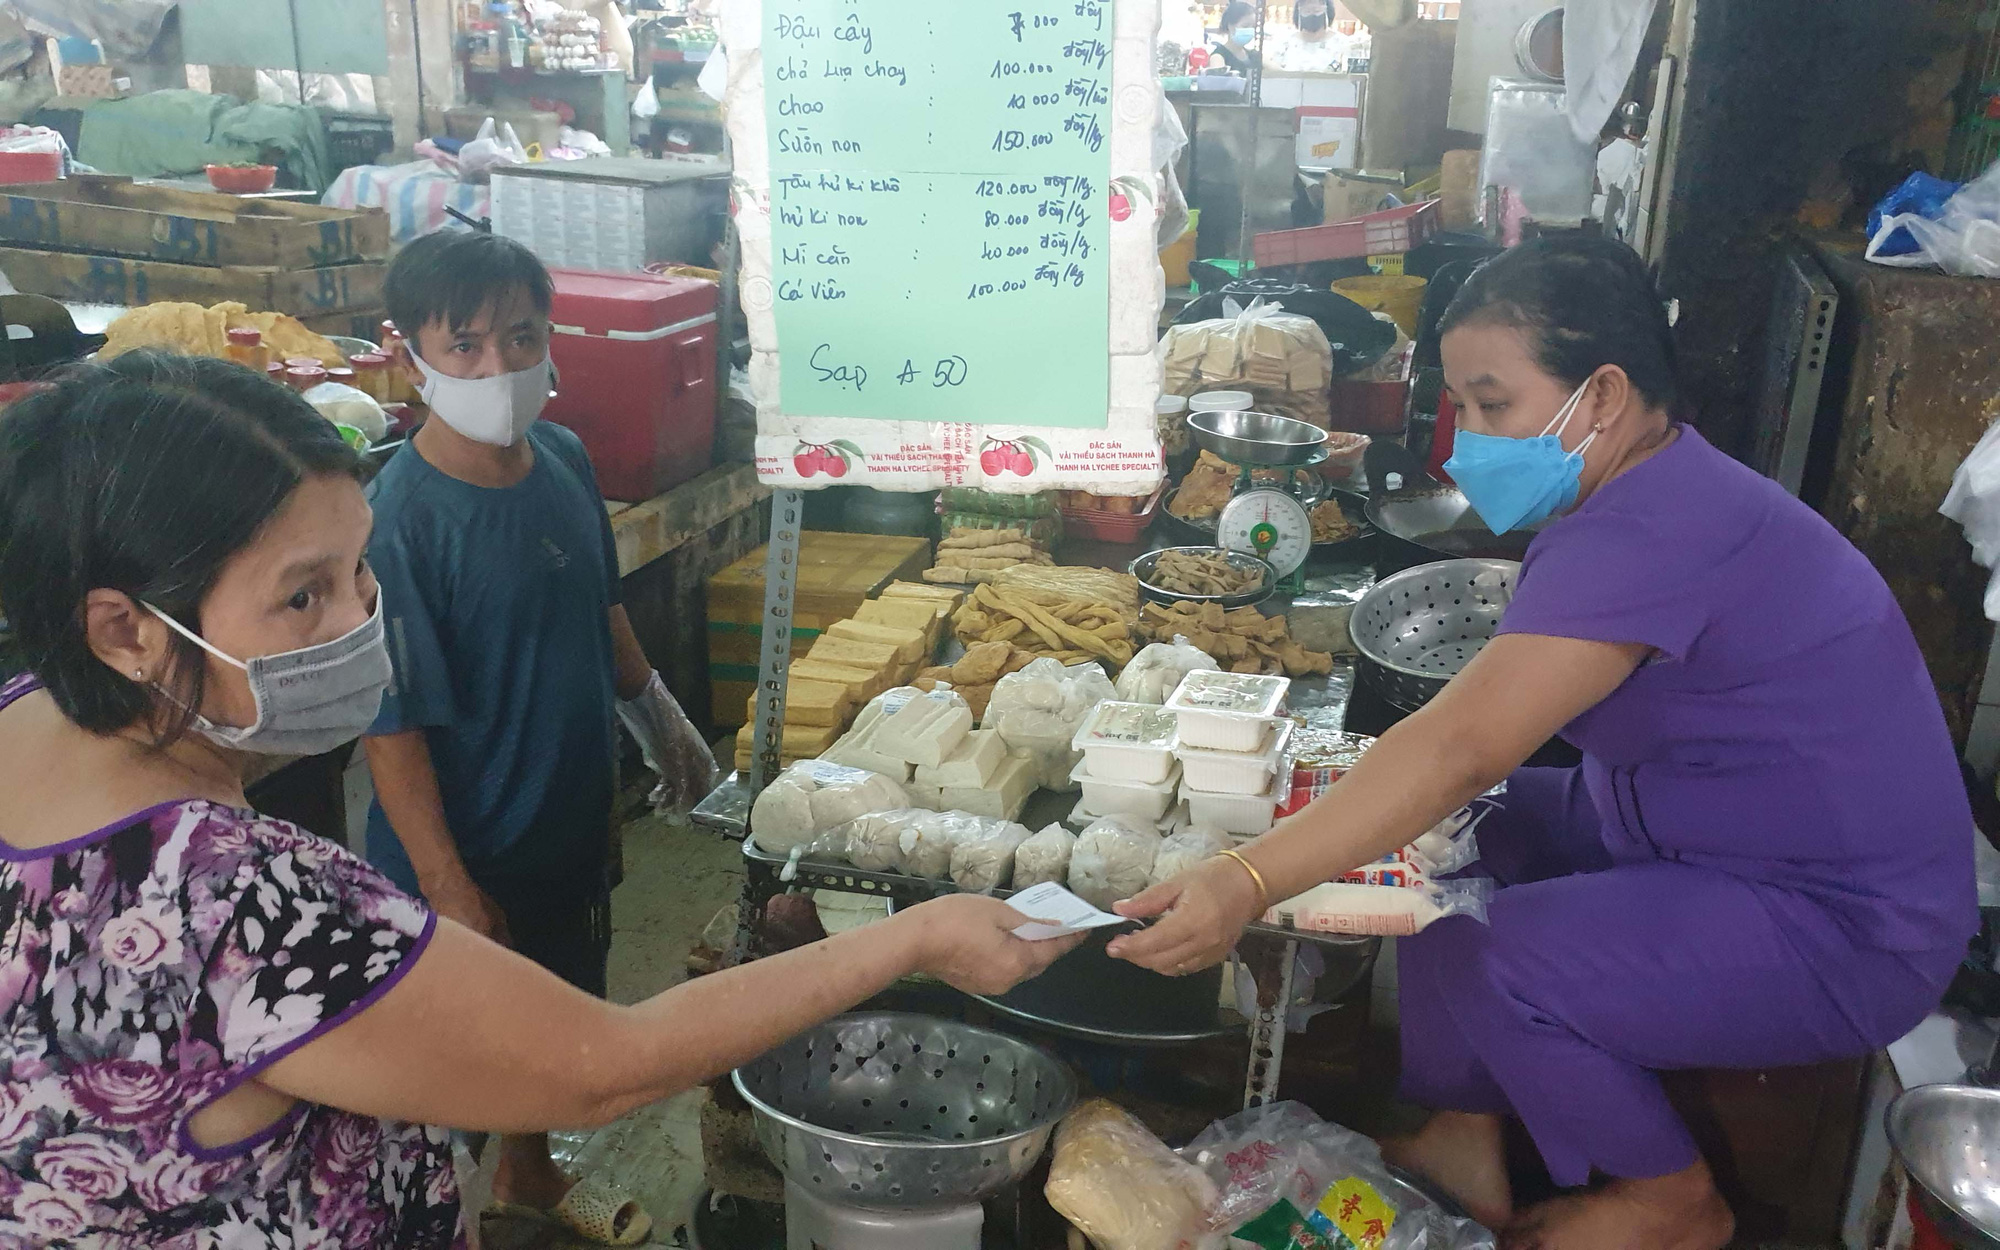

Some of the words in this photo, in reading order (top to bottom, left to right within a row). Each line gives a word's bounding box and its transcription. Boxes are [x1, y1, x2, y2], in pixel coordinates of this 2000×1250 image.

[773, 14, 820, 49] Đậu
[833, 13, 873, 54] cây
[864, 59, 907, 86] chay
[990, 59, 1054, 79] 100.000
[831, 139, 862, 153] non
[991, 129, 1054, 153] 150.000
[975, 179, 1037, 197] 120.000
[838, 212, 868, 226] non
[984, 209, 1029, 228] 80.000
[778, 277, 804, 301] Cá
[967, 279, 1027, 300] 100.000
[810, 343, 868, 391] Sạp
[896, 358, 922, 386] A
[932, 354, 968, 388] 50
[867, 465, 891, 473] THANH
[892, 465, 901, 473] HA
[1055, 464, 1079, 472] THANH
[1092, 463, 1120, 471] LYCHEE
[1121, 463, 1159, 471] SPECIALTY
